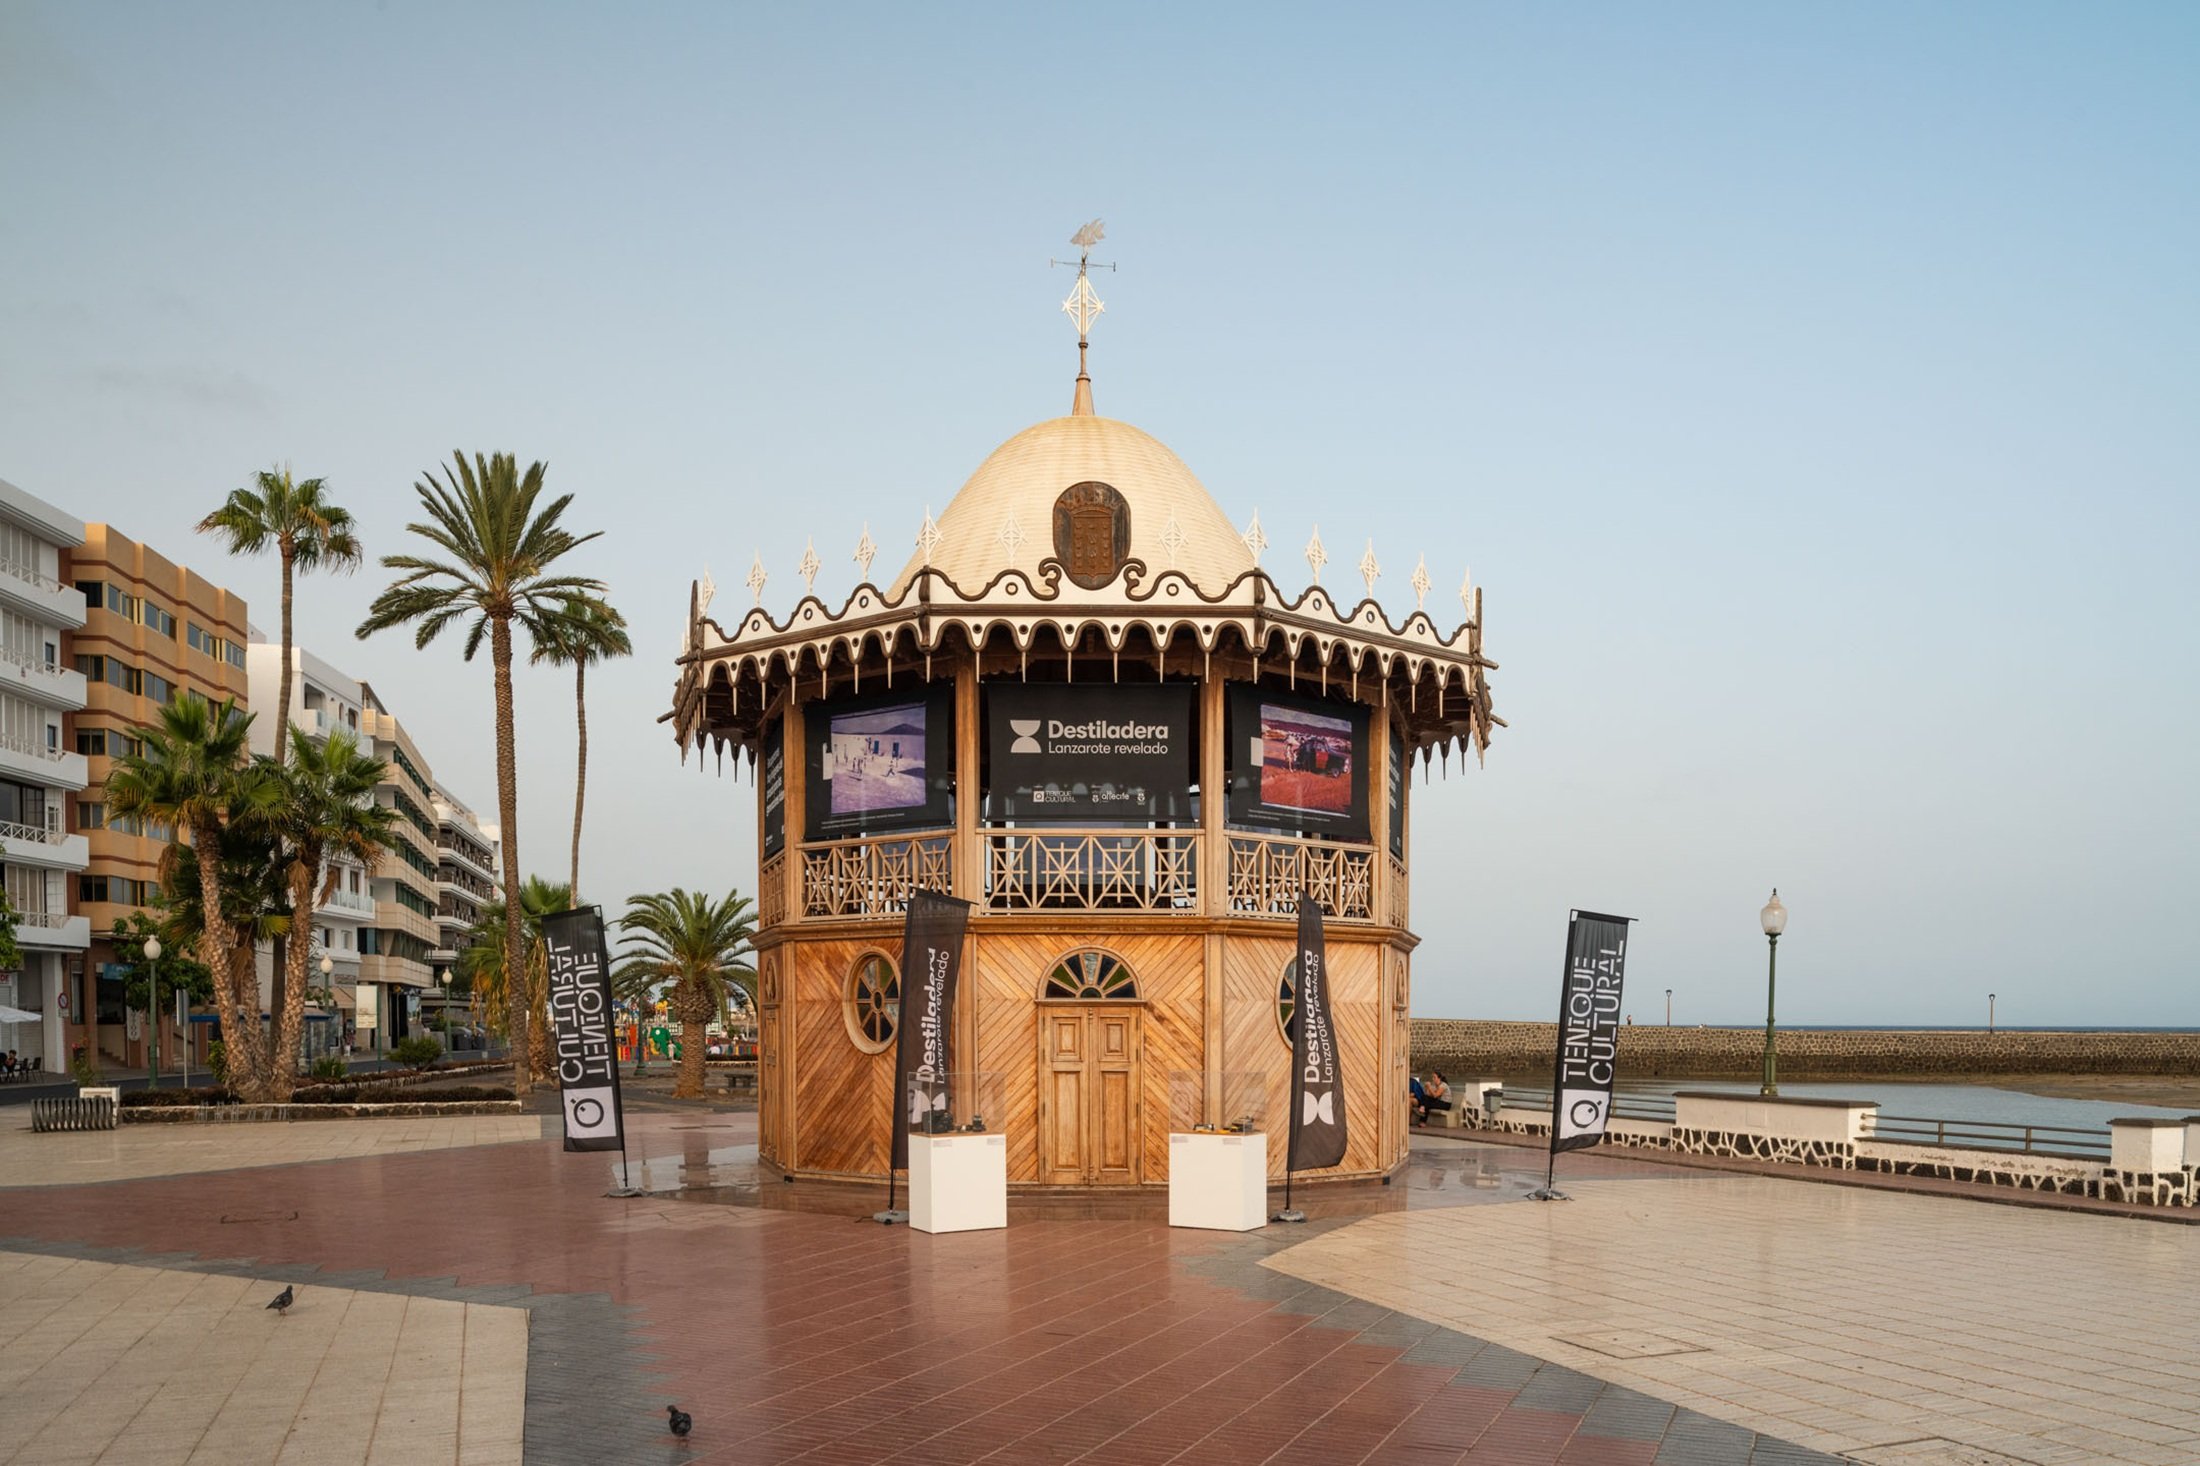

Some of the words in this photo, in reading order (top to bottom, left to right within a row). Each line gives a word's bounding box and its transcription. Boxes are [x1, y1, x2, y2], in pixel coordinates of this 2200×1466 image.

[1048, 720, 1169, 739] Destiladera
[1048, 741, 1111, 754] Lanzarote
[1114, 741, 1169, 755] revelado
[916, 947, 937, 1083] Destiladera
[935, 950, 950, 1012] revelado
[1312, 954, 1321, 1013] revelado
[1589, 940, 1624, 1084] CULTURAL
[936, 1014, 945, 1084] Lanzarote
[1304, 949, 1321, 1083] Destiladera
[1317, 1016, 1334, 1083] Lanzarote
[1562, 956, 1596, 1083] TENIQUE
